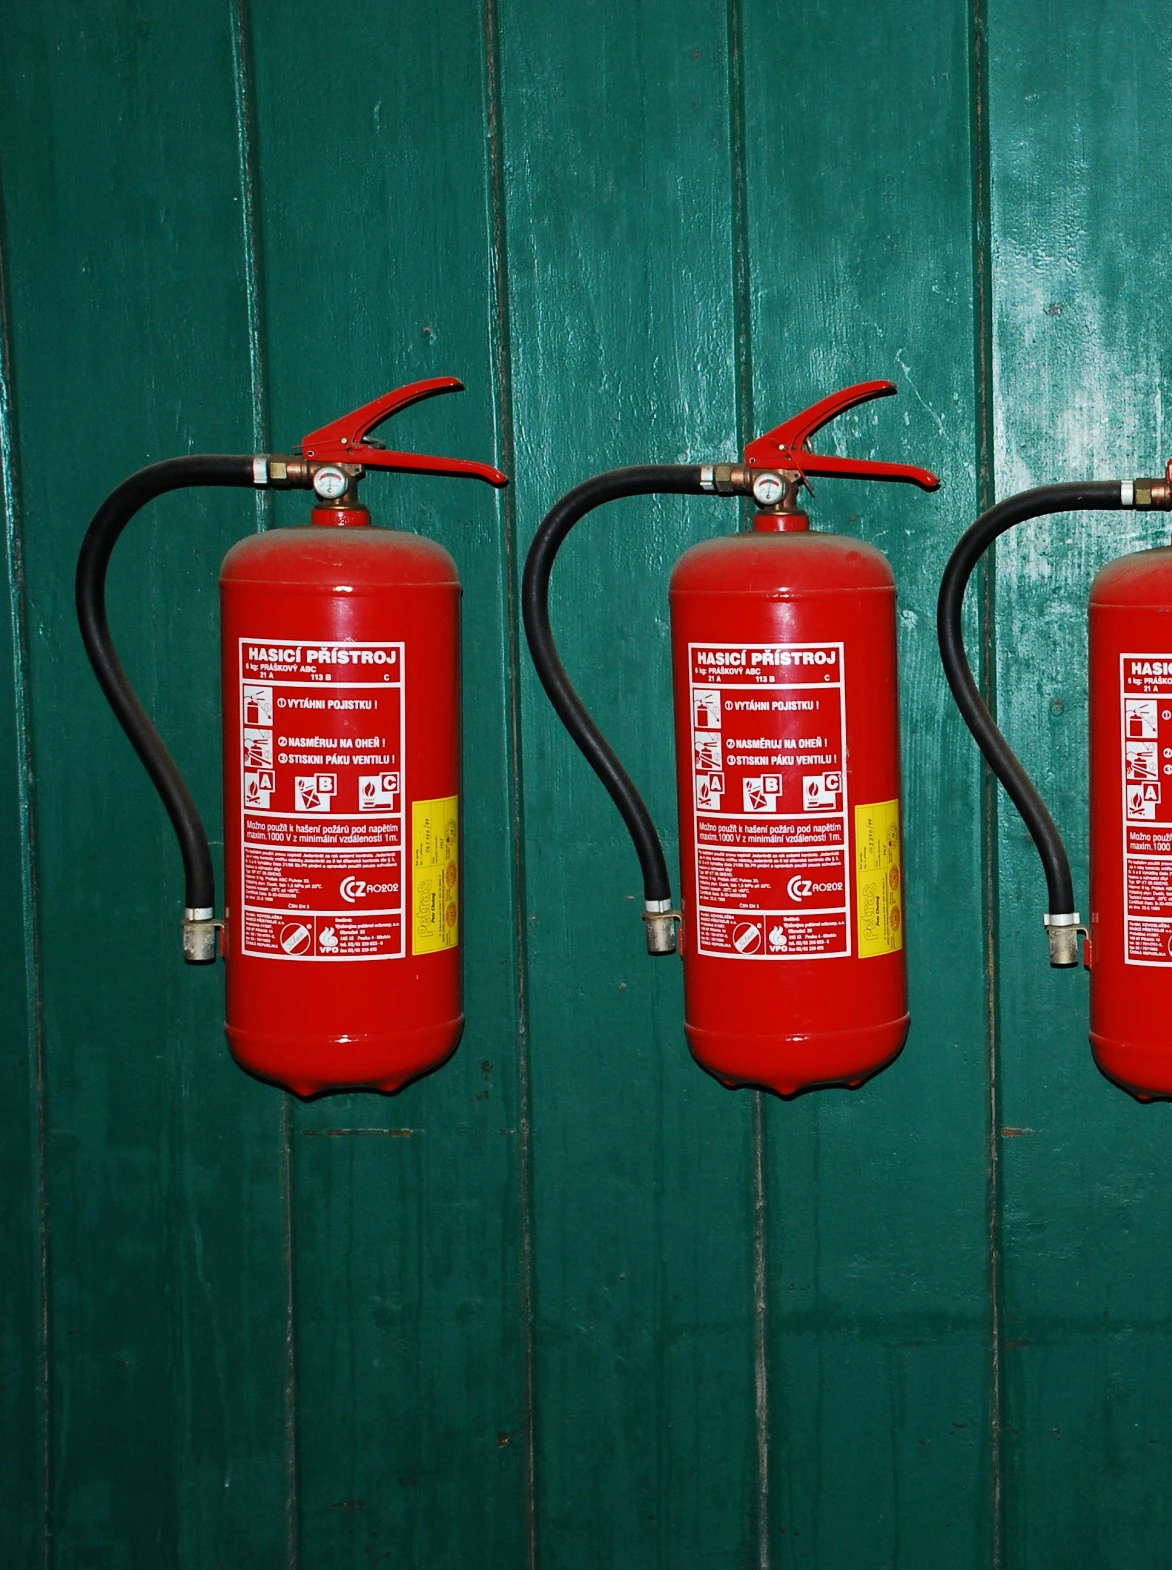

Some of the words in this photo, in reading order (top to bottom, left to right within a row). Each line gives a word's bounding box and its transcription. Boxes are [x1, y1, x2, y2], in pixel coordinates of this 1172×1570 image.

[249, 647, 302, 662] HASICÍ
[307, 647, 396, 664] PŘÍSTROJ
[698, 650, 747, 665] HASICÍ
[752, 650, 836, 665] PŘÍSTROJ
[260, 662, 298, 672] PRÁŠKOVÝ
[288, 698, 325, 709] VYTÁHNI
[328, 700, 372, 710] POJISTKU
[734, 700, 770, 710] VYTÁHNI
[772, 701, 814, 710] POJISTKU
[289, 737, 337, 748] NASMĚRUJ
[340, 739, 352, 747] NA
[355, 737, 379, 748] OHEŇ
[736, 738, 782, 749] NASMĚRUJ
[784, 740, 796, 748] NA
[799, 736, 822, 748] OHEŇ
[289, 755, 323, 764] STISKNI
[326, 754, 349, 764] PÁKU
[352, 755, 389, 764] VENTILU
[736, 756, 769, 765] STISKNI
[772, 754, 794, 765] PÁKU
[796, 755, 831, 765] VENTILU
[260, 774, 271, 788] A
[319, 777, 333, 791] B
[383, 776, 396, 790] C
[711, 777, 720, 790] A
[766, 778, 778, 791] B
[826, 775, 838, 789] C
[1145, 786, 1157, 800] A
[247, 820, 265, 830] Možno
[268, 823, 287, 832] použít
[296, 824, 320, 833] hašení
[323, 825, 349, 834] požárů
[351, 825, 366, 834] pod
[369, 824, 398, 833] napětím
[247, 831, 267, 840] maxim.
[268, 833, 284, 841] 1000
[299, 834, 337, 842] minimální
[340, 834, 382, 843] vzdálenosti
